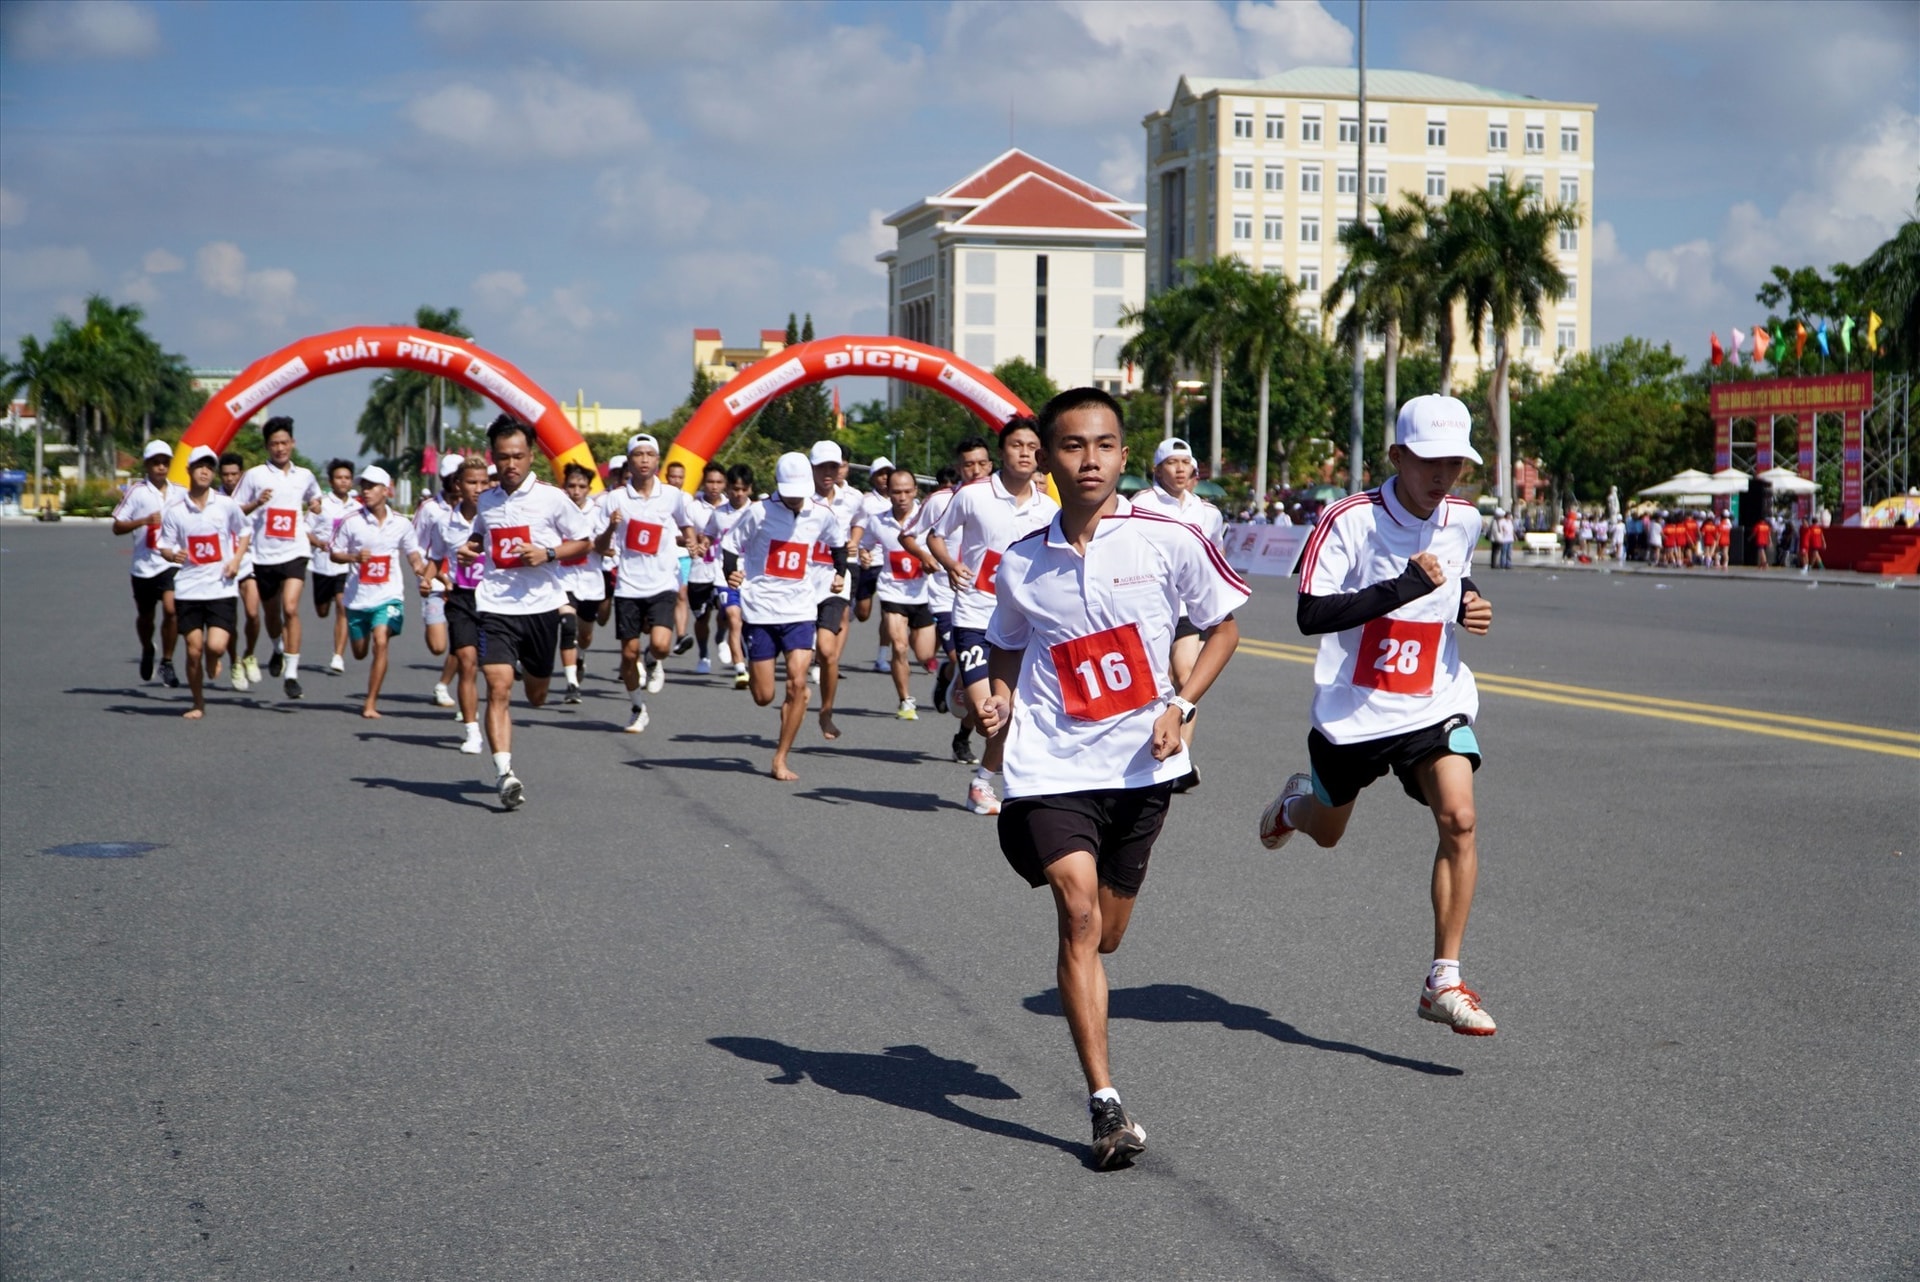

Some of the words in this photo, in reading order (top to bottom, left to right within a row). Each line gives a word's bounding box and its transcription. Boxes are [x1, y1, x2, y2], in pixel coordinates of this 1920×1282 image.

[272, 515, 292, 531] 23
[638, 529, 650, 546] 6
[194, 542, 216, 558] 24
[777, 550, 801, 570] 18
[901, 557, 912, 573] 8
[367, 562, 386, 577] 25
[960, 645, 987, 672] 22
[1373, 638, 1422, 675] 28
[1076, 651, 1132, 700] 16
